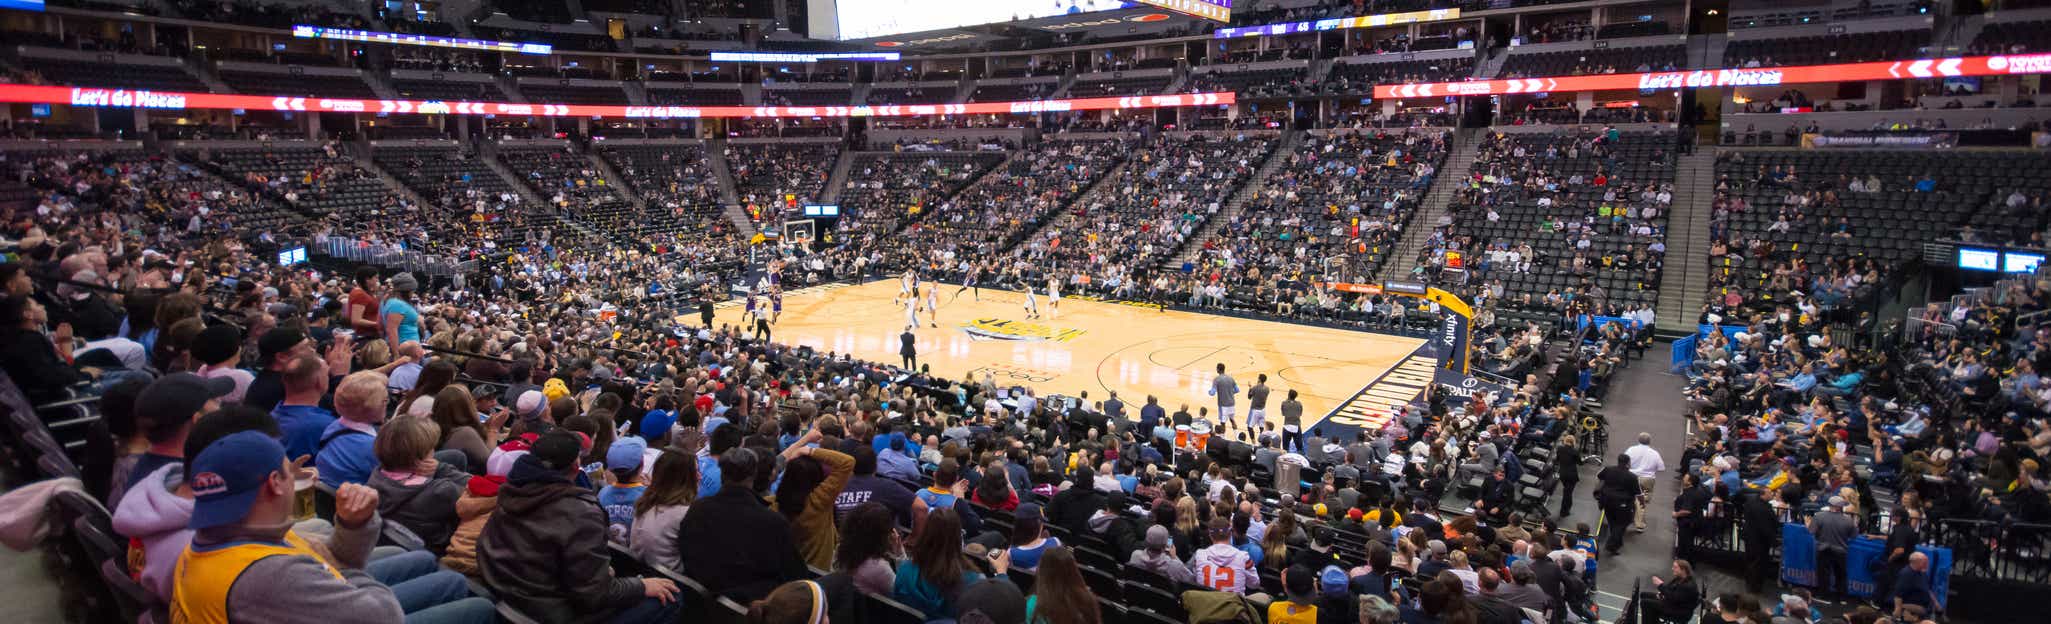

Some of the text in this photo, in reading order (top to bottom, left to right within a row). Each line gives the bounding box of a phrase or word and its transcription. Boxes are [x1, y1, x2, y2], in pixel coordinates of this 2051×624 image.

[2008, 57, 2051, 68] TOYOT
[1639, 69, 1782, 89] Let's Go Places
[111, 90, 132, 107] Go
[1443, 313, 1458, 346] xfinity
[834, 491, 872, 505] STAFF
[1202, 565, 1234, 592] 12
